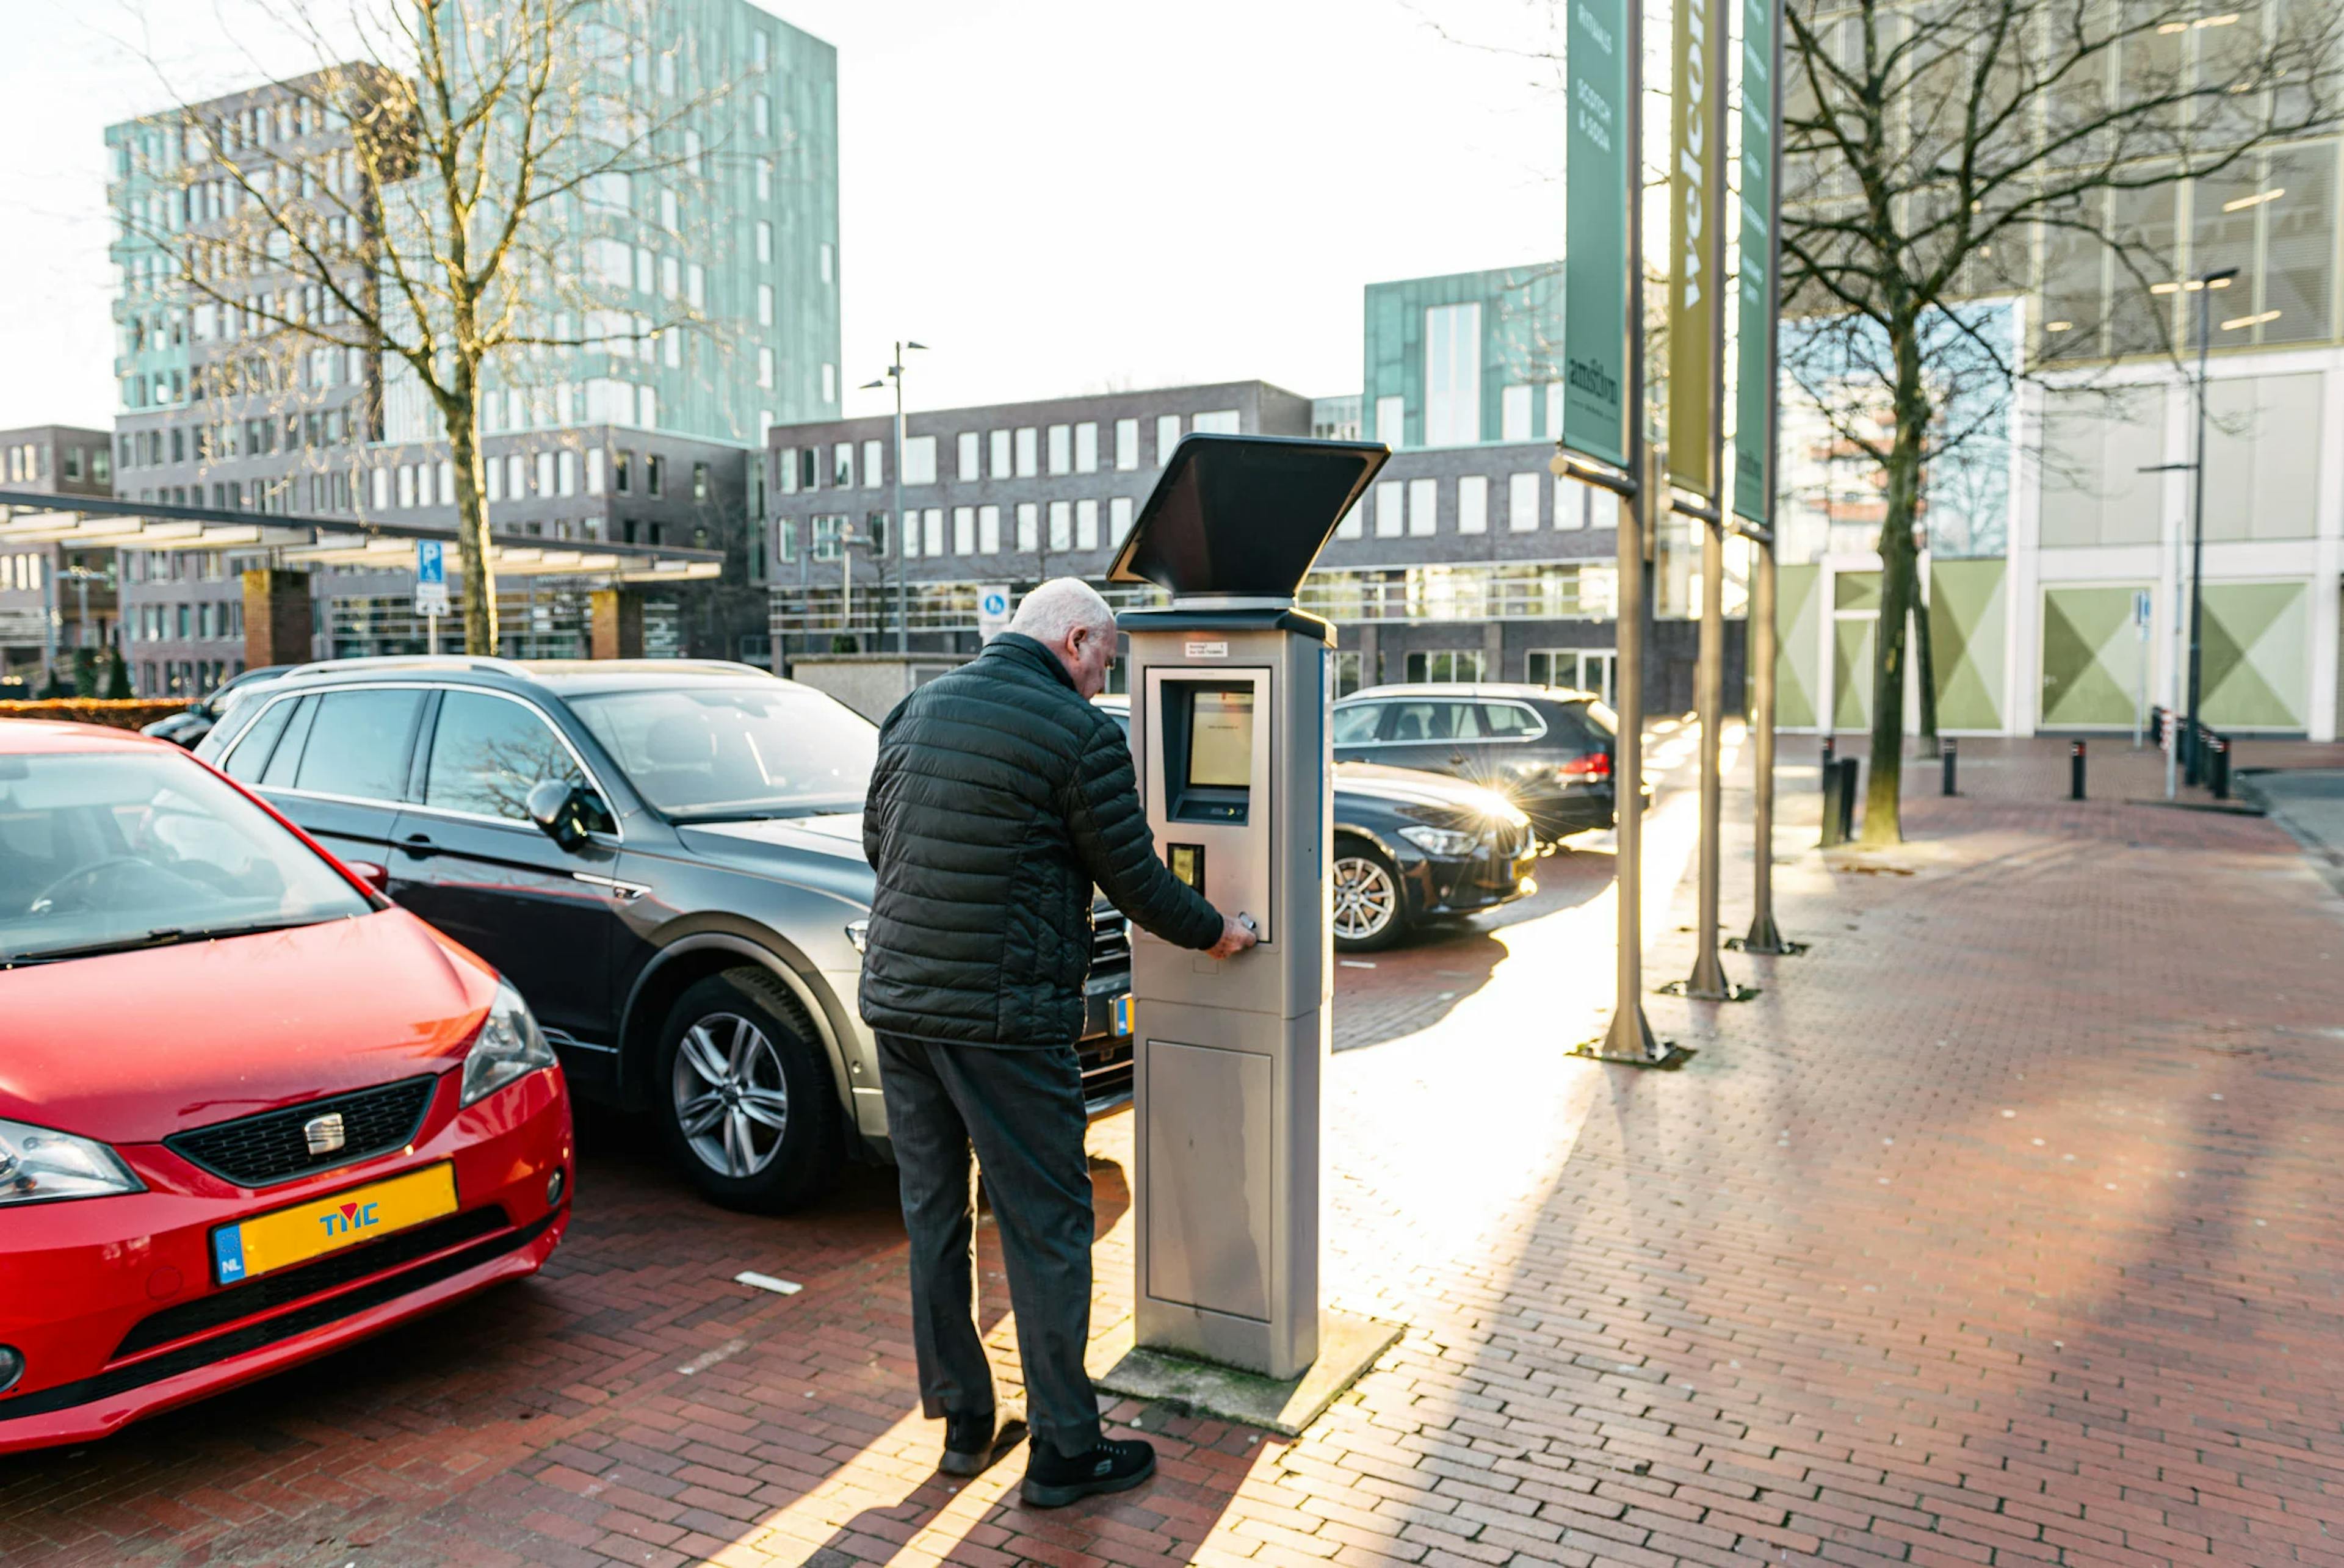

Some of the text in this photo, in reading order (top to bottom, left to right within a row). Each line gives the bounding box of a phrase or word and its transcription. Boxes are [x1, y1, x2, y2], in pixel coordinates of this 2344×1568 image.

[423, 541, 440, 566] P
[319, 1201, 379, 1237] TMC
[222, 1257, 242, 1274] NL
